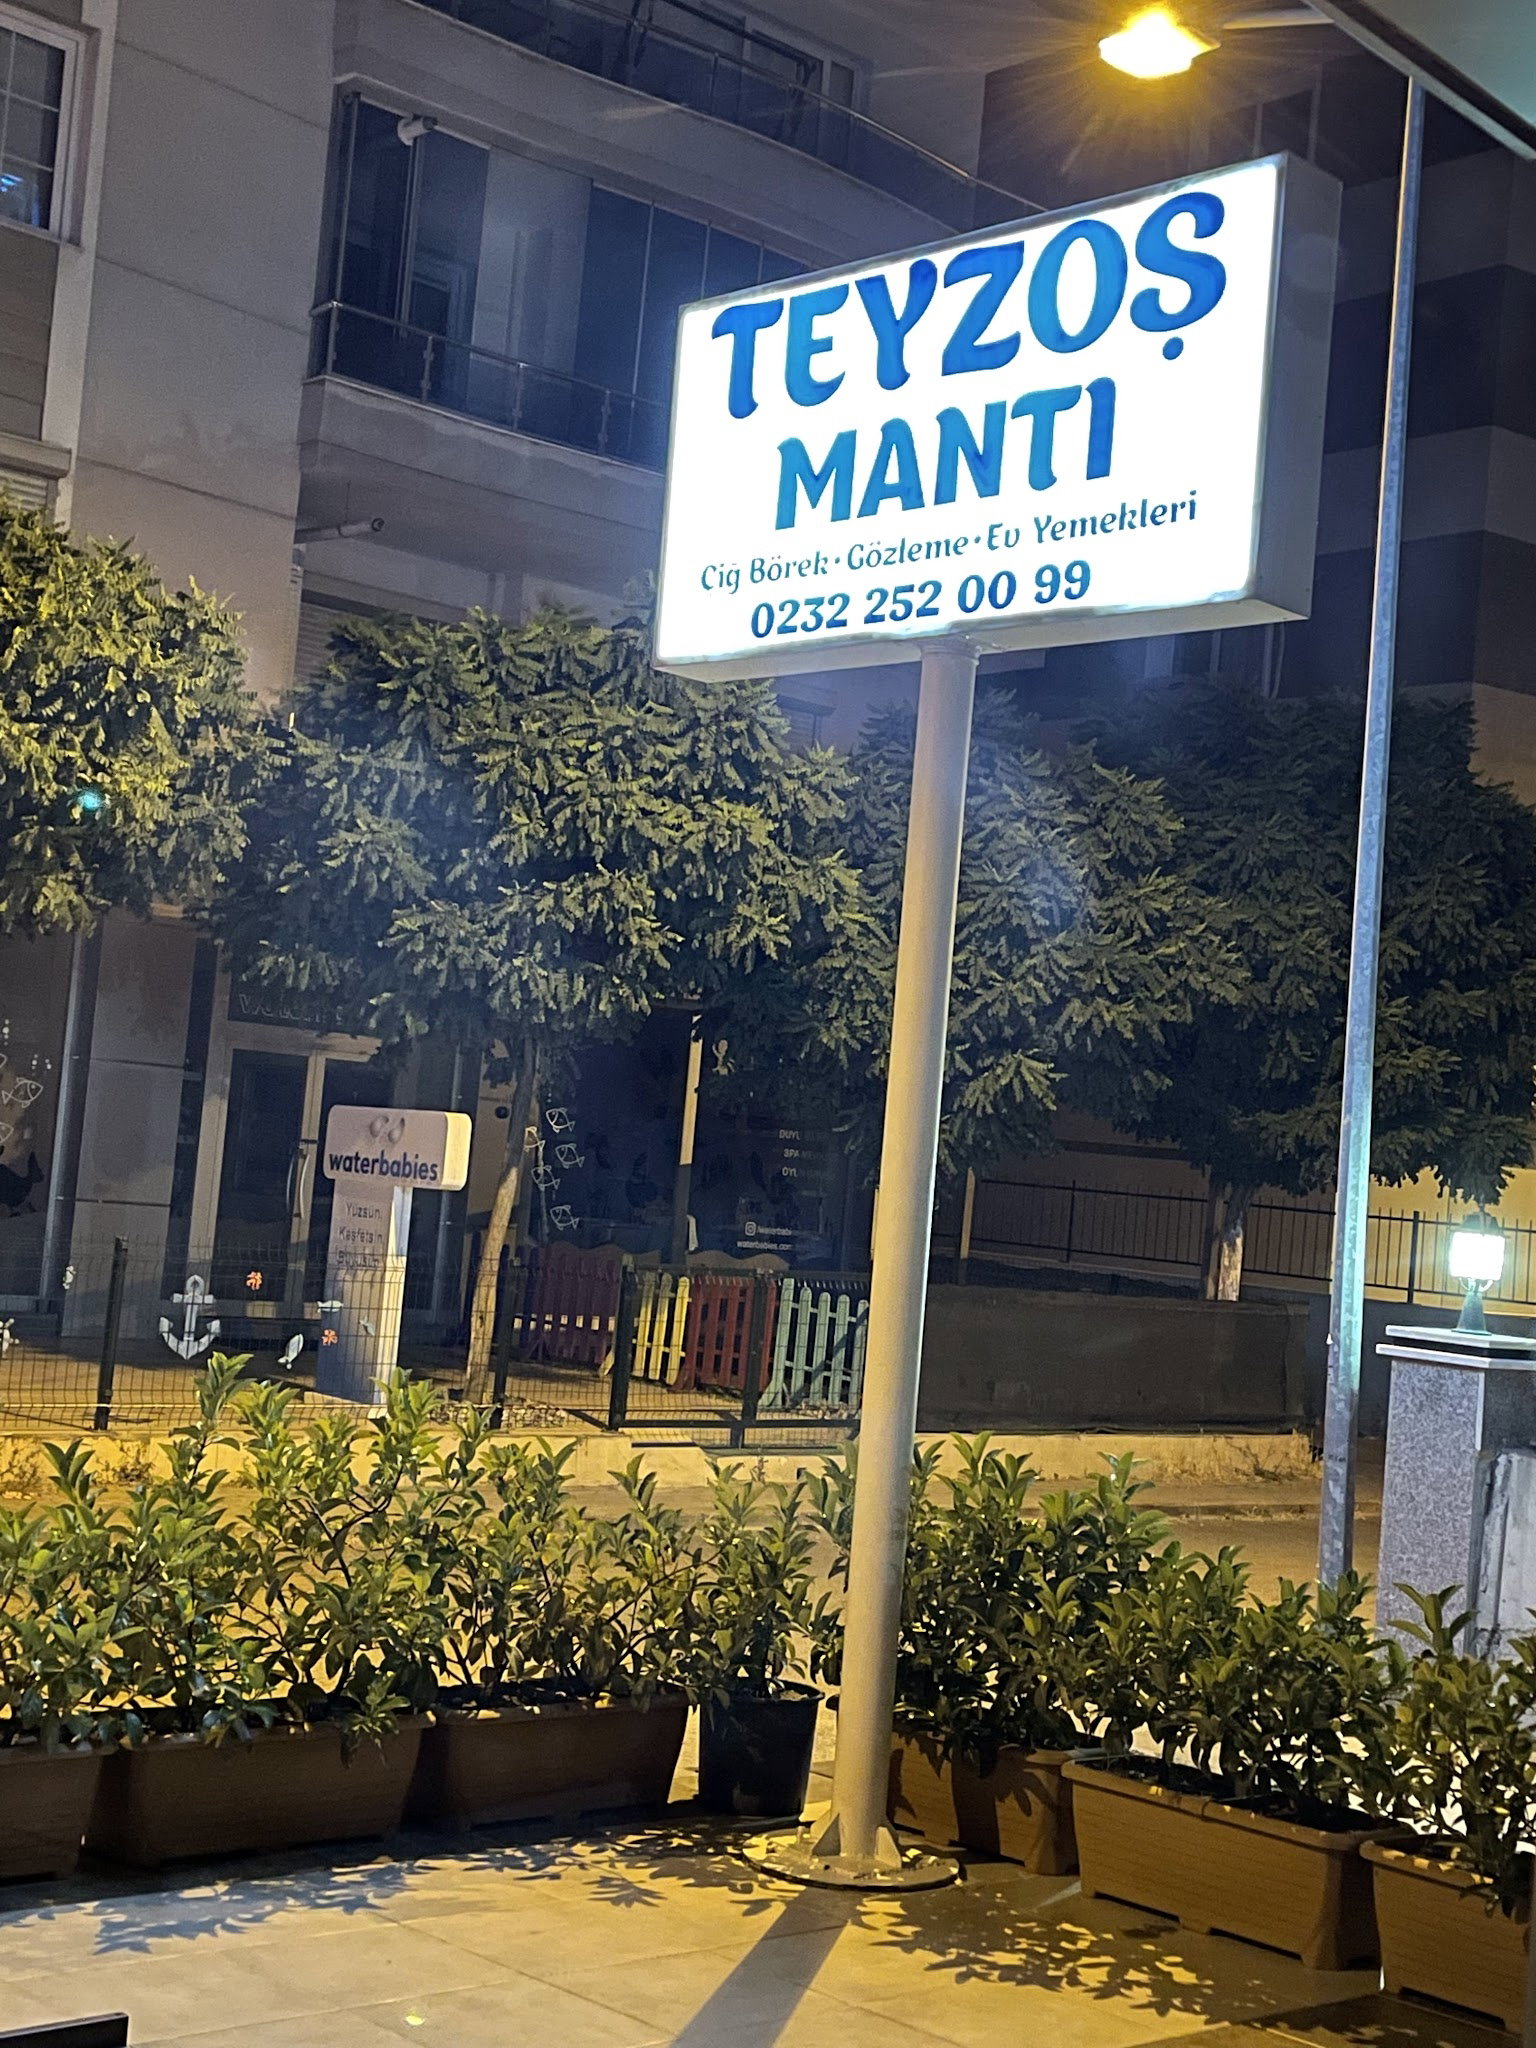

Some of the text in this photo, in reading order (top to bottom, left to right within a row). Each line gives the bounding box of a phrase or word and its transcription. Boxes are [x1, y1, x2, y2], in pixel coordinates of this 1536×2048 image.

[711, 191, 1227, 419] TEYZOŞ
[775, 377, 1116, 530] MANTI
[749, 550, 829, 584] Börek
[847, 536, 969, 571] Gözleme
[986, 523, 1020, 551] Ev
[1033, 490, 1197, 546] Yemekleri
[750, 559, 1092, 639] 0232 252 00 99
[328, 1149, 439, 1181] waterbabies
